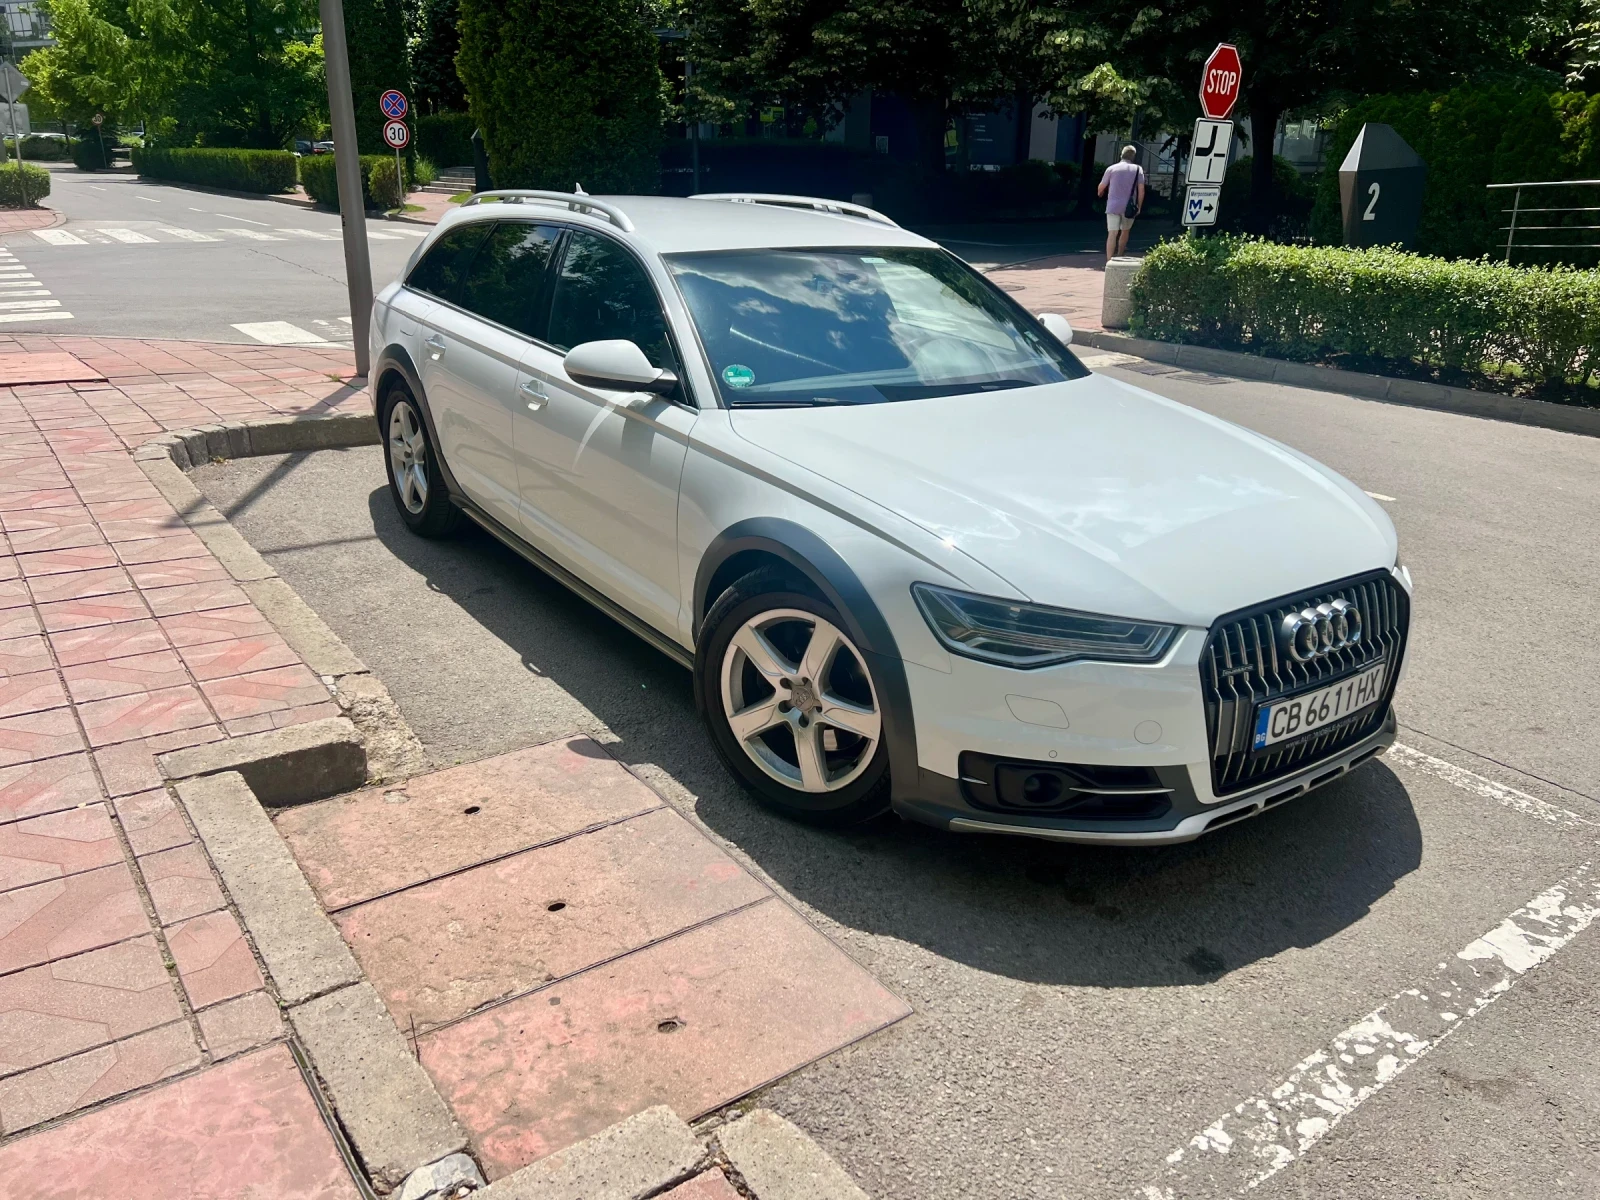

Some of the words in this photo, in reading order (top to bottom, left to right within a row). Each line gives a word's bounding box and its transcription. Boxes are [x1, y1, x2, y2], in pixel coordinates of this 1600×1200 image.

[1207, 69, 1236, 95] STOP
[389, 127, 404, 141] 30
[1363, 182, 1380, 221] 2
[1305, 681, 1353, 727] 6611
[1255, 732, 1266, 744] BG
